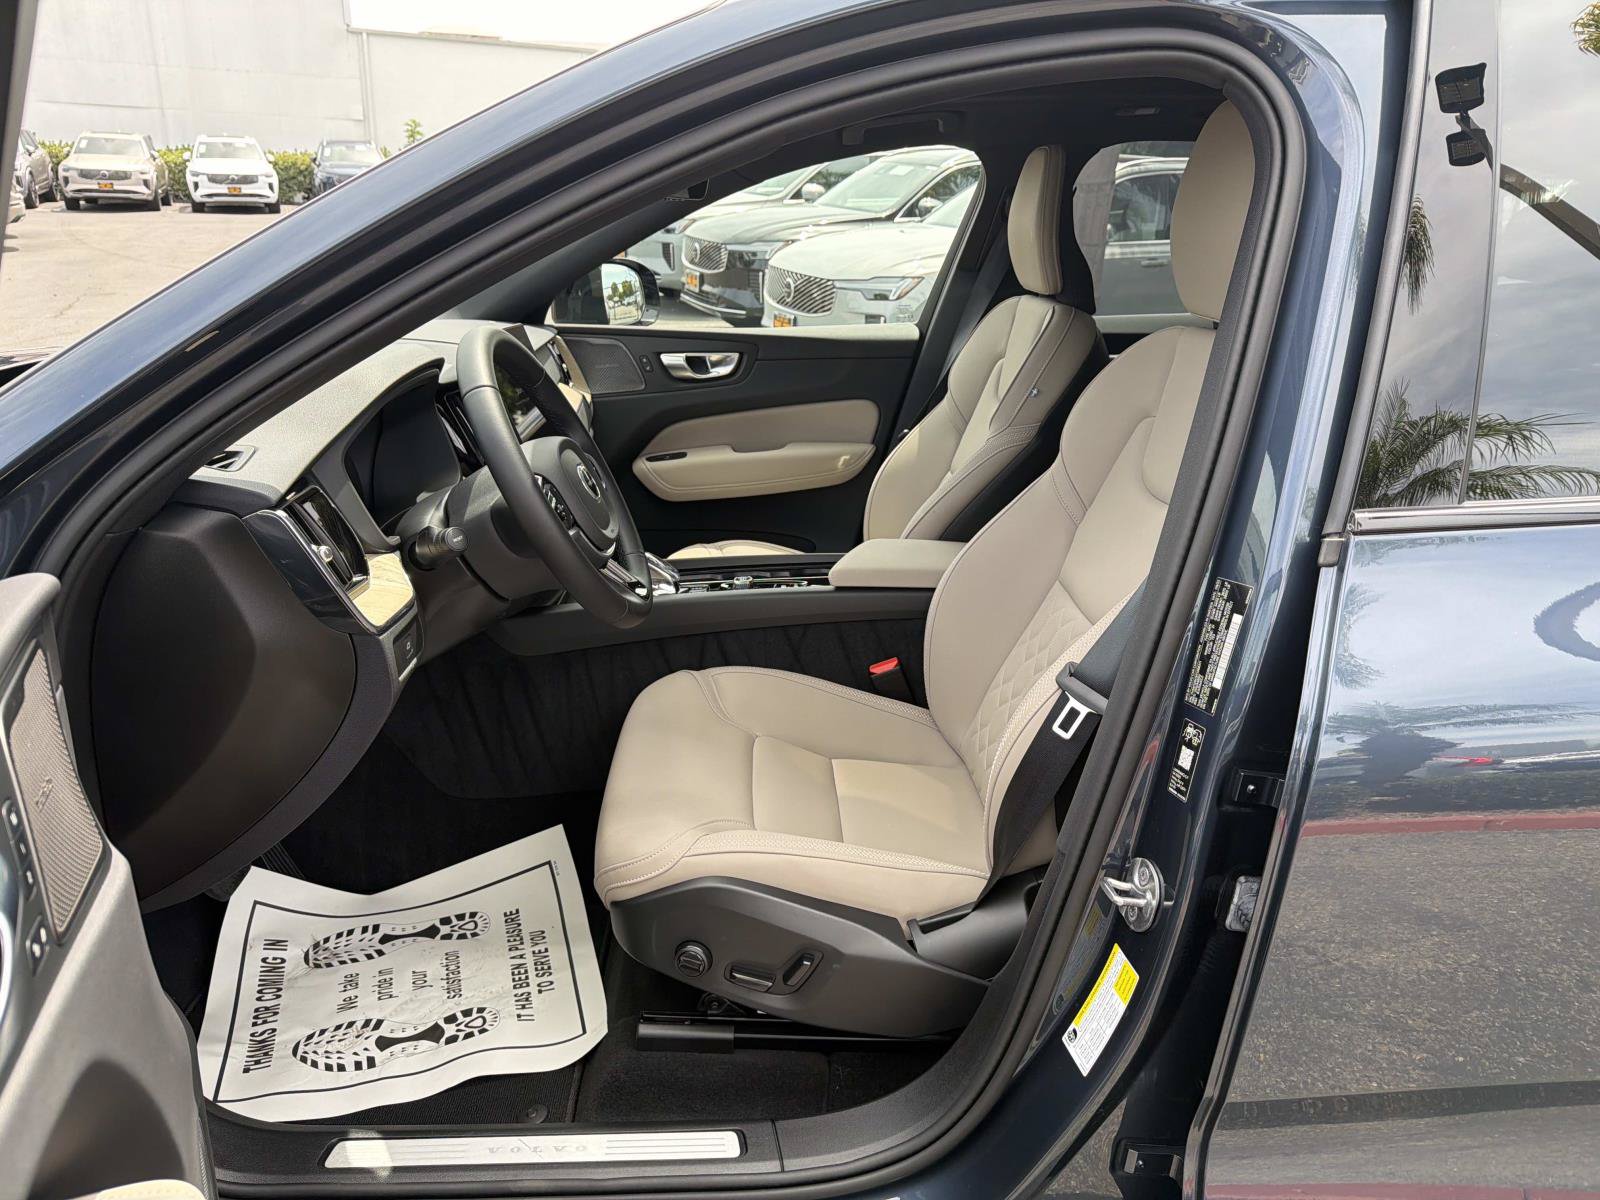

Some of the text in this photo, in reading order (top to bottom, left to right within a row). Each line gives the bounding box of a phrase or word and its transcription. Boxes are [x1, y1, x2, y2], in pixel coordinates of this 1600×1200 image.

[372, 967, 400, 1001] pride in
[412, 969, 434, 992] your
[440, 950, 463, 1000] satisfaction
[503, 907, 536, 1022] IT HAS BEEN A PLEASURE
[529, 929, 556, 995] TO SERVE YOU
[242, 938, 288, 1074] THANKS FOR COMING IN
[336, 972, 360, 1014] We take
[488, 1144, 588, 1154] VOLVO
